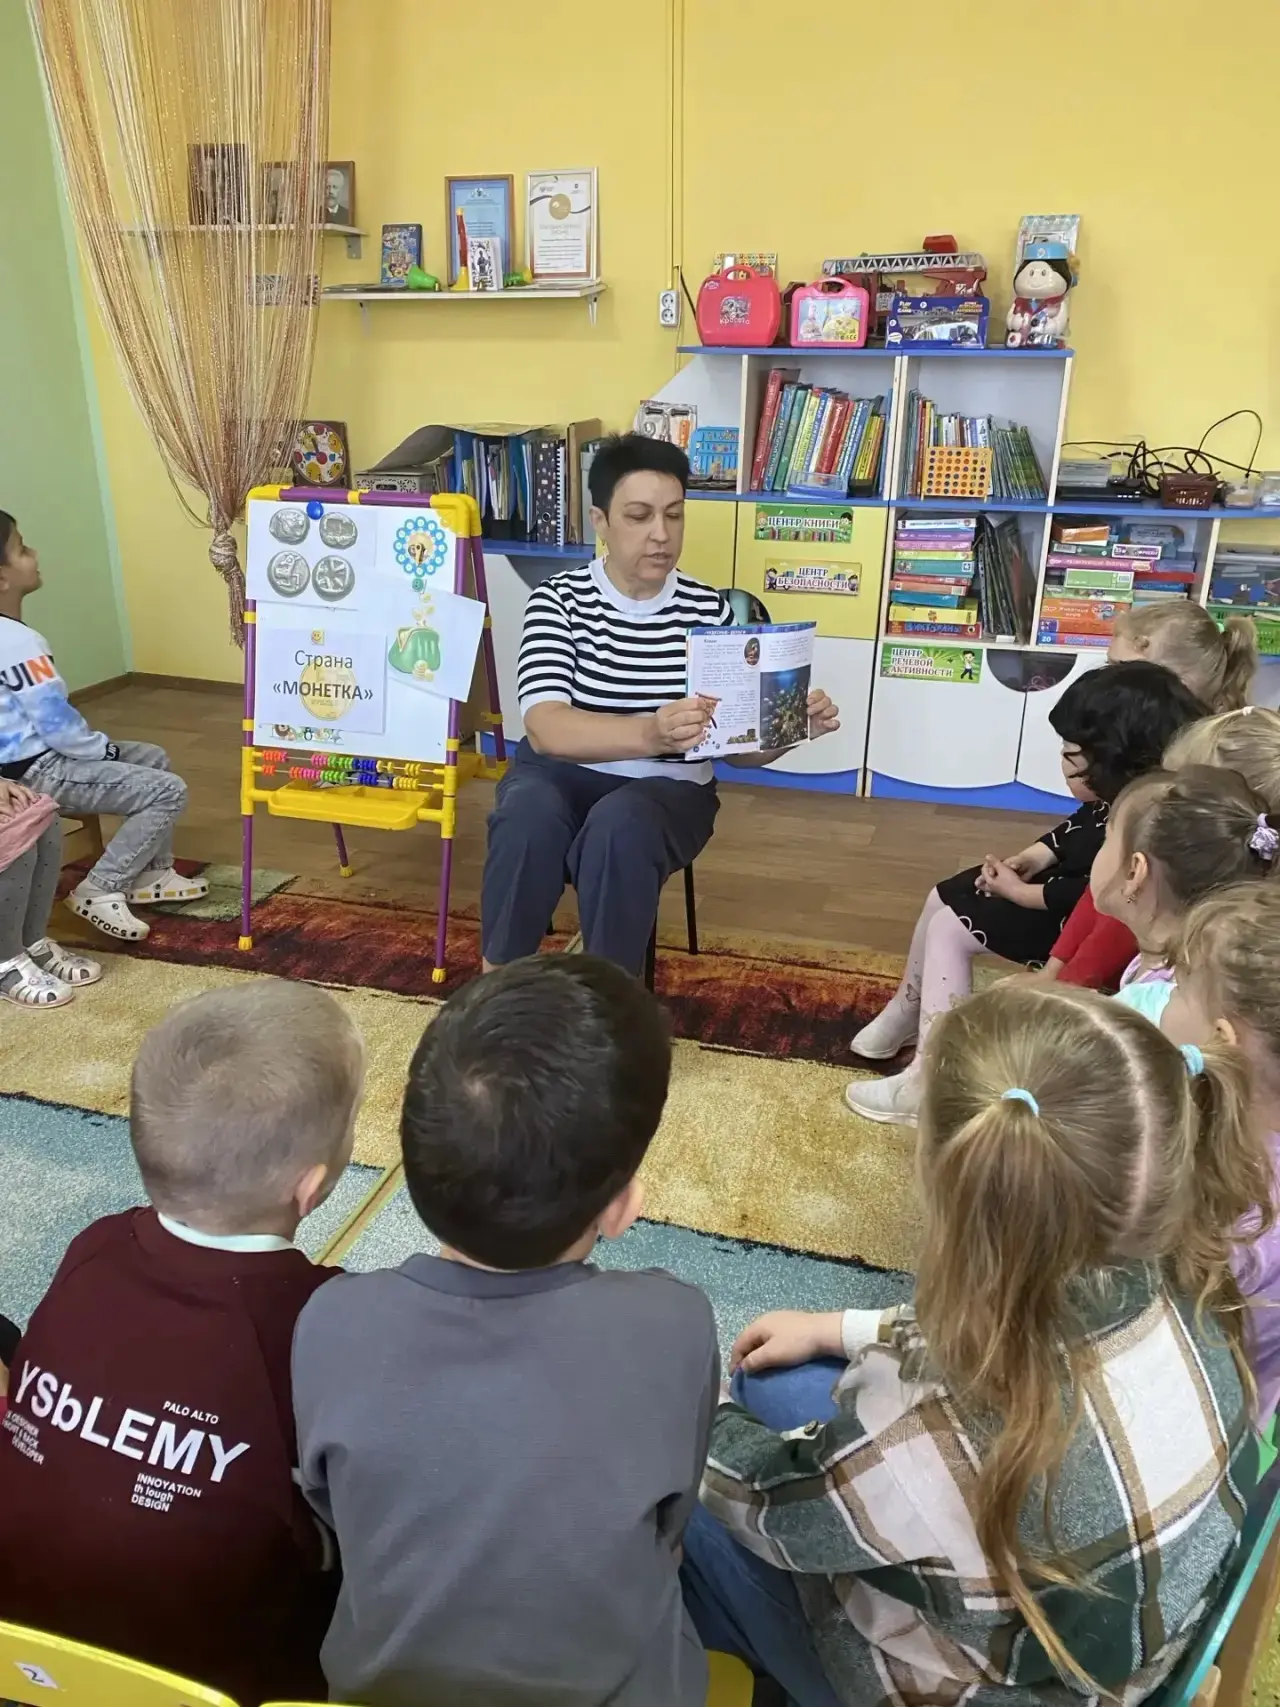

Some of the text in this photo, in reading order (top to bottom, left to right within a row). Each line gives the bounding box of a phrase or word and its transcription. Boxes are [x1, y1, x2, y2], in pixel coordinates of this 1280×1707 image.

[768, 516, 802, 527] ЦЕНТР
[798, 567, 829, 578] ЦЕНТР
[776, 576, 849, 589] БЕЗОПАСНОСТИ
[891, 648, 923, 658] ЦЕНТР
[294, 649, 354, 671] Страна
[891, 657, 934, 668] РЕЧЕВОЙ
[890, 666, 953, 678] АКТИВНОСТИ
[272, 680, 374, 700] «МОНЕТКА»
[90, 915, 127, 938] crocs
[162, 1400, 220, 1425] PALO ALTO
[131, 1493, 170, 1513] DESIGN
